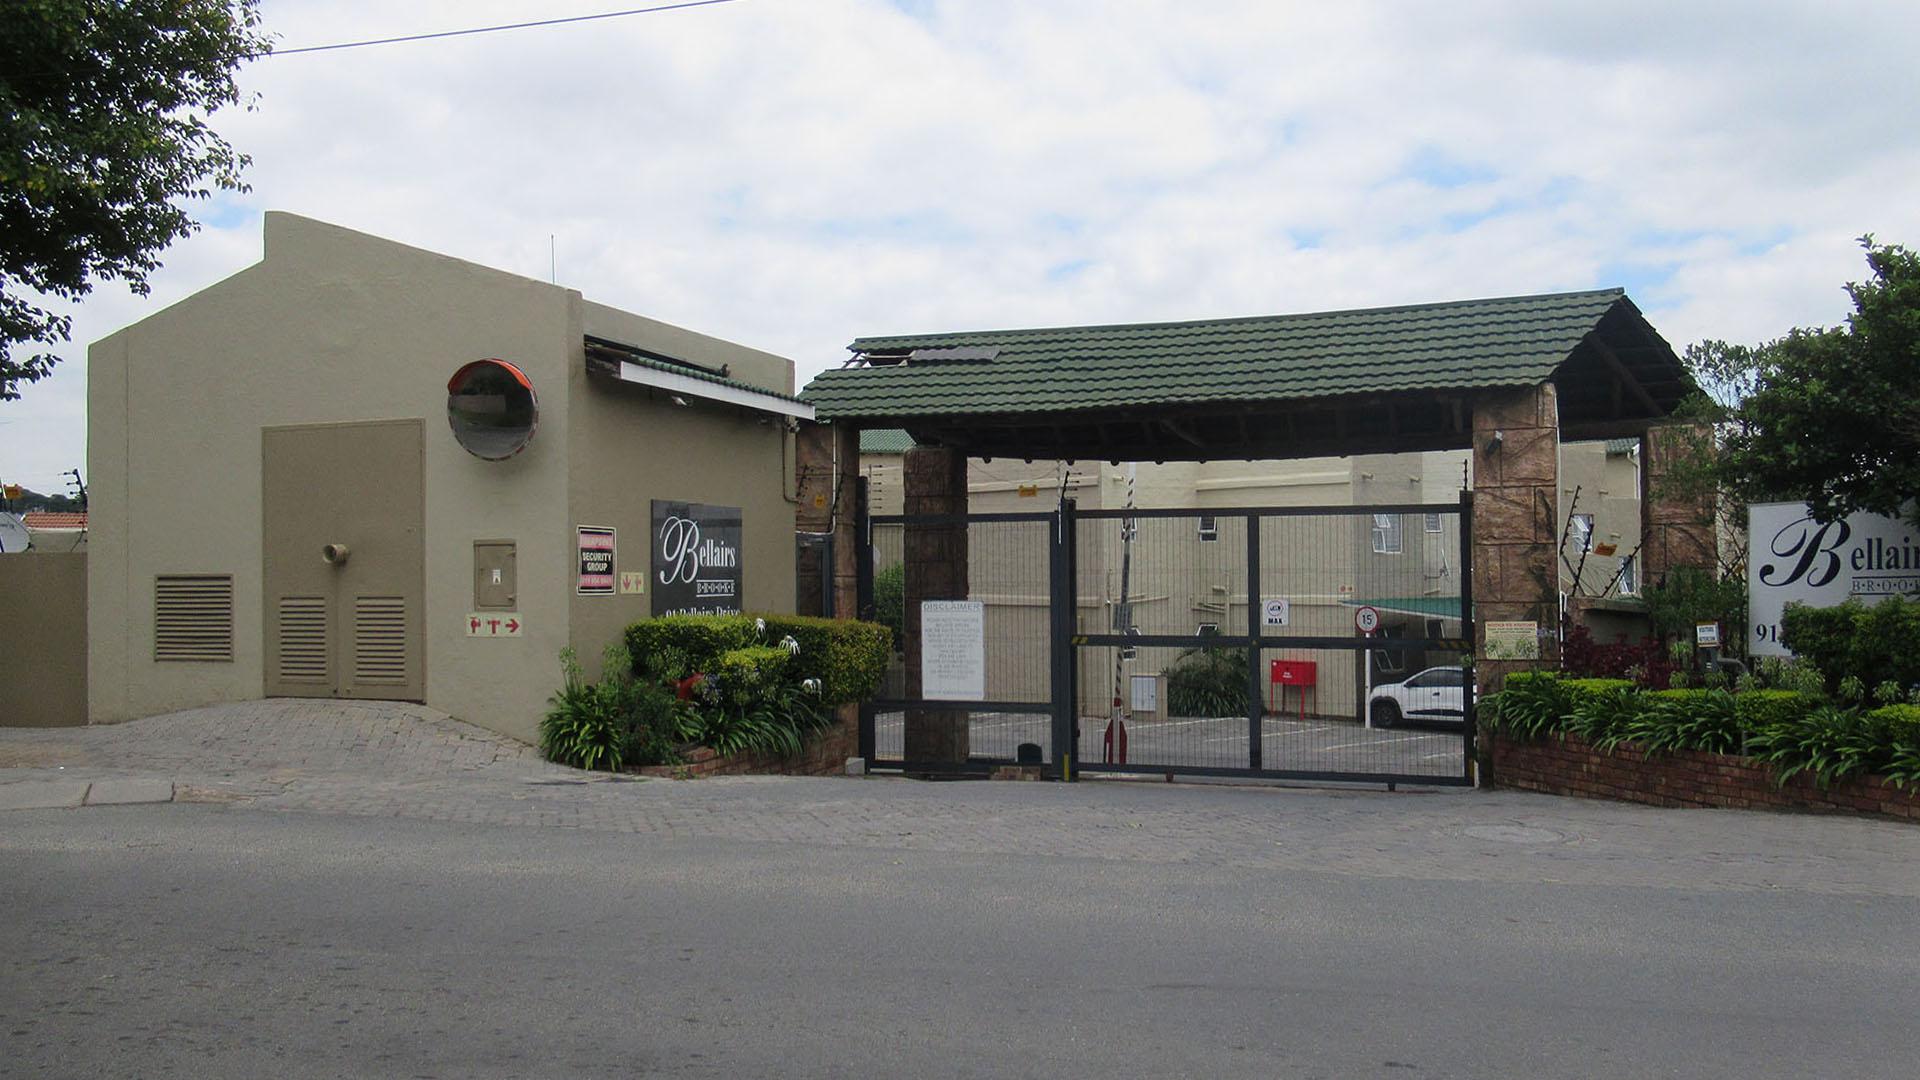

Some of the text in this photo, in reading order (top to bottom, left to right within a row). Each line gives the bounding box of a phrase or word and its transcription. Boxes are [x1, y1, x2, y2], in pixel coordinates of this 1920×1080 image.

[659, 516, 736, 585] Bellairs
[582, 551, 613, 562] SECURITY
[586, 562, 608, 572] GROUP
[924, 603, 980, 611] DISCLAIMER
[1362, 614, 1372, 625] 15
[1756, 624, 1776, 642] 91
